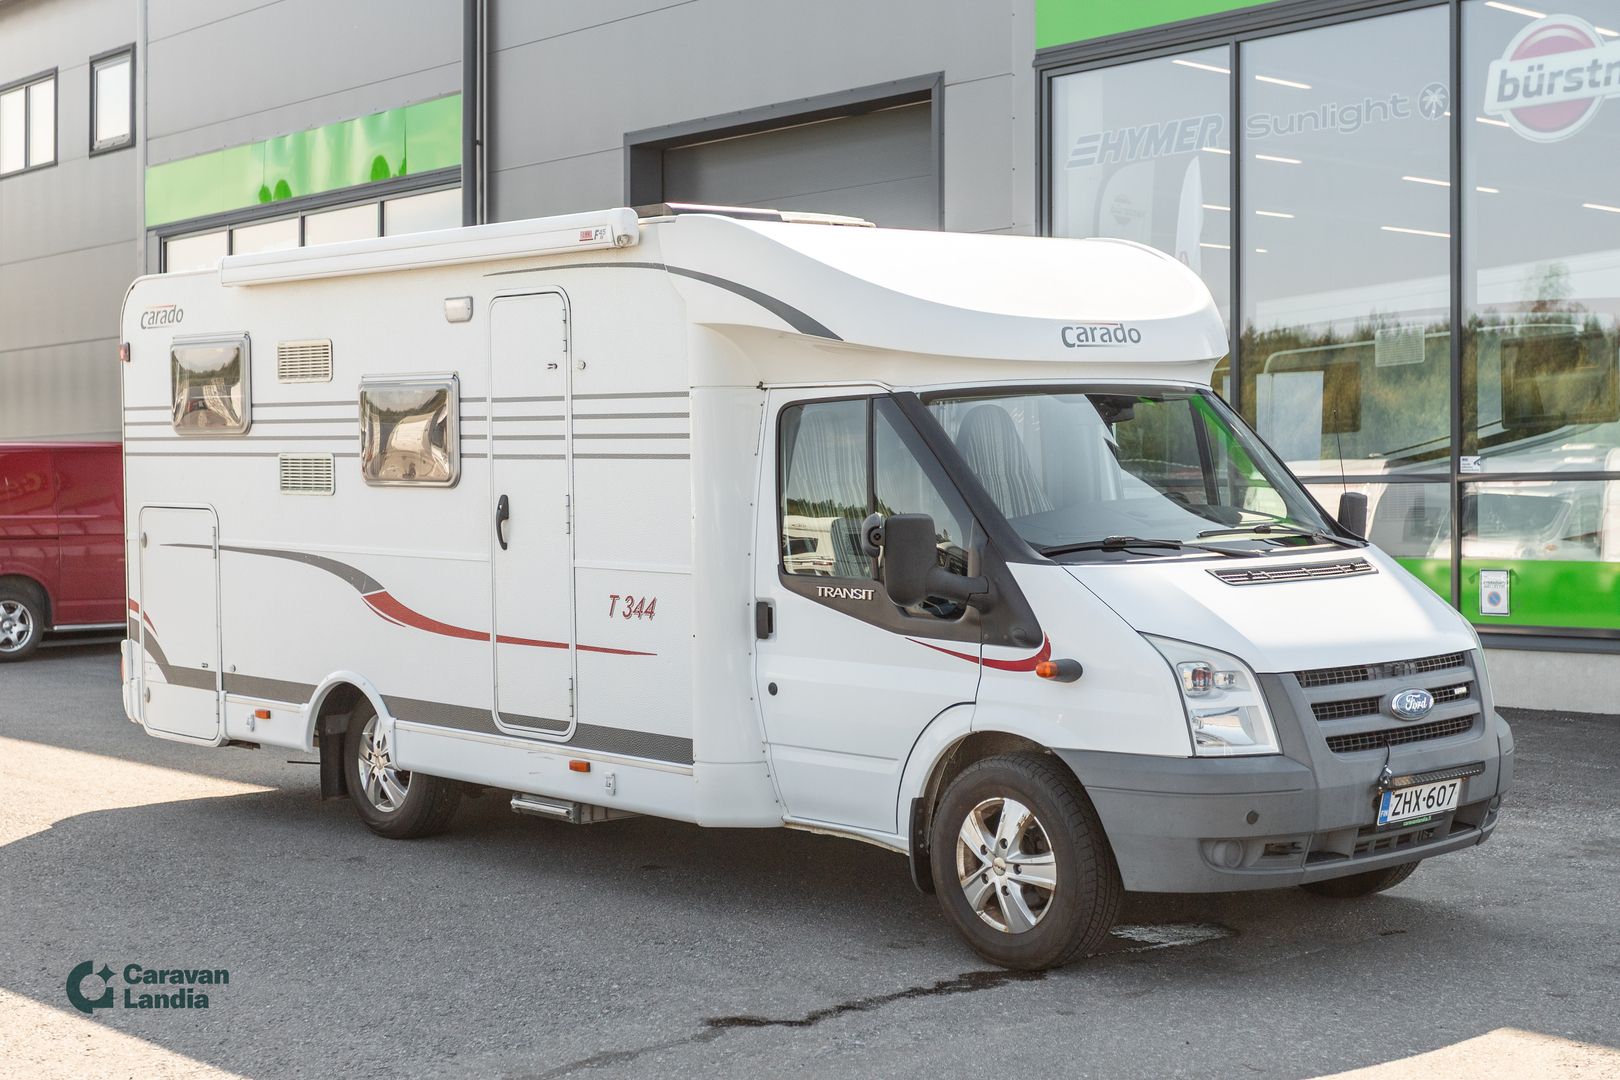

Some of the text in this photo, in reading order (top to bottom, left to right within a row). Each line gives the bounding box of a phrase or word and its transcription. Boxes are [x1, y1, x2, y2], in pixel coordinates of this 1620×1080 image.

[1094, 112, 1225, 166] HYMER
[816, 585, 875, 600] TRANSIT
[609, 594, 657, 621] T 344
[1405, 694, 1428, 711] Ford
